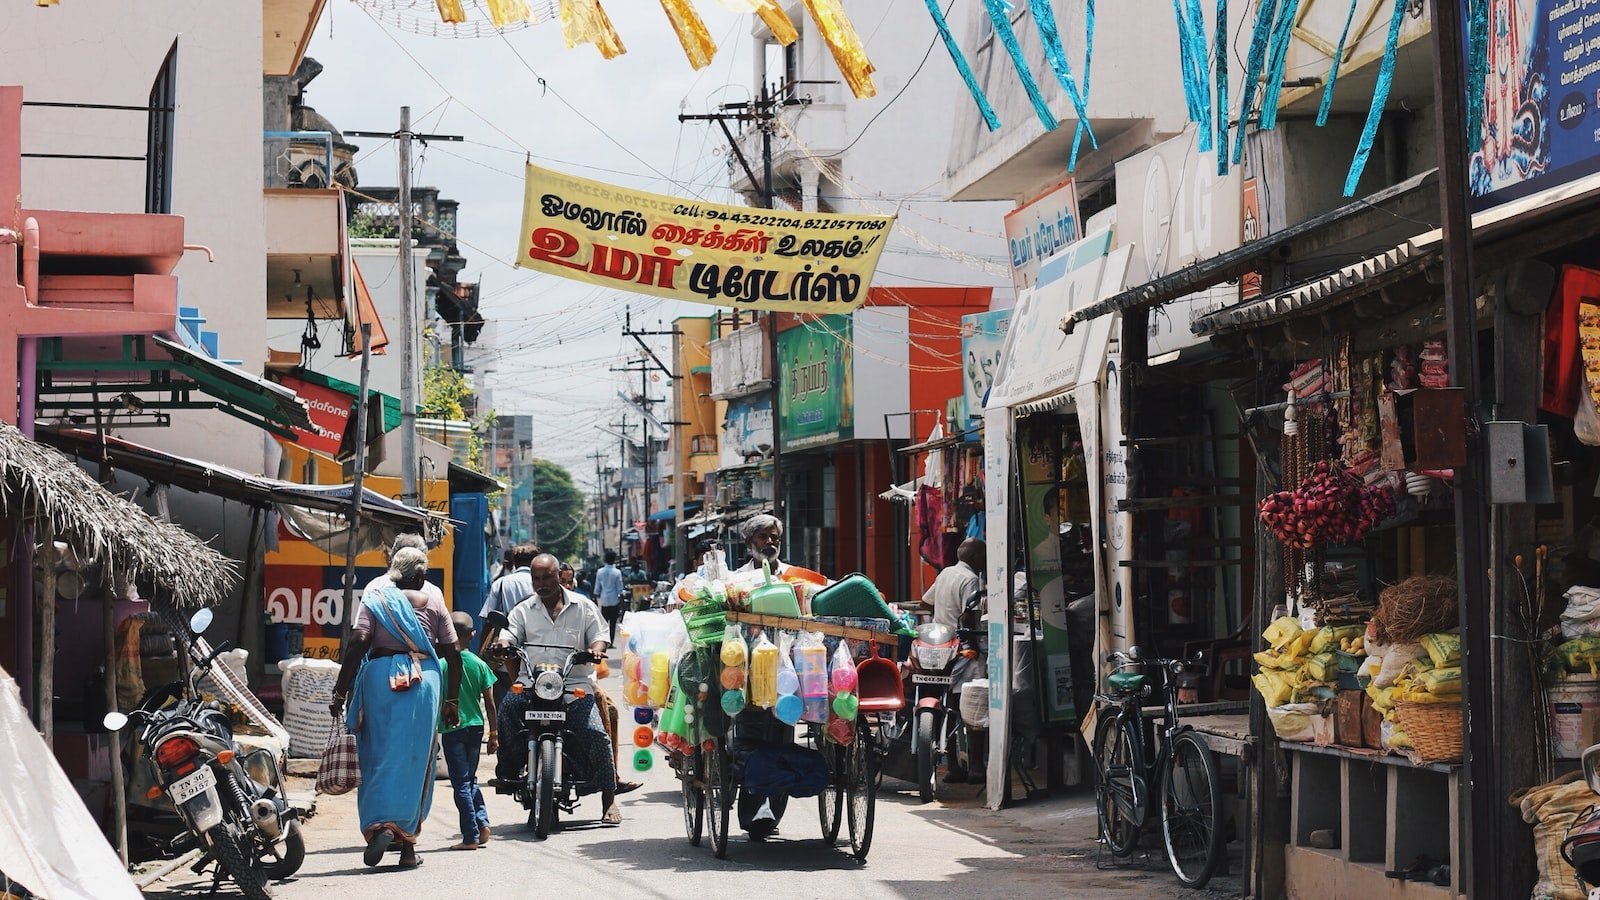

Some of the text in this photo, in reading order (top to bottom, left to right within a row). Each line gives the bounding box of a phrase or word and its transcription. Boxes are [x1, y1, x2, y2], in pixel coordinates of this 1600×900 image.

[1178, 157, 1212, 257] LG
[528, 226, 861, 303] உமர் டிரேடர்ஸ்
[1011, 208, 1075, 269] உமர் டிரேடர்ஸ்
[179, 773, 204, 791] TN 30
[188, 780, 210, 796] 9157
